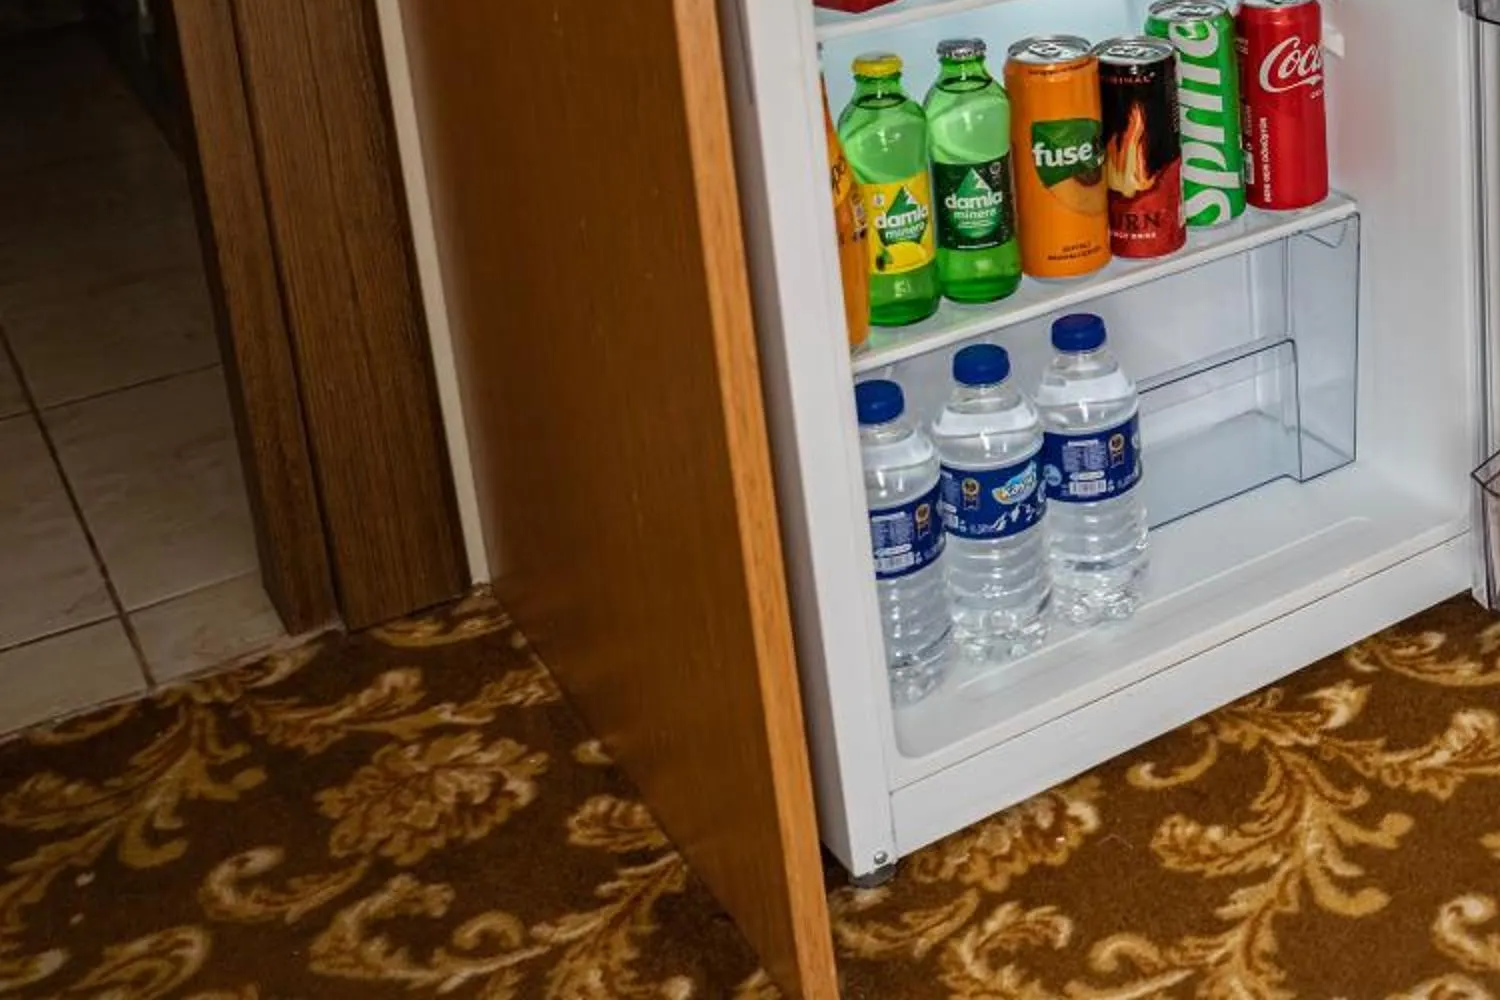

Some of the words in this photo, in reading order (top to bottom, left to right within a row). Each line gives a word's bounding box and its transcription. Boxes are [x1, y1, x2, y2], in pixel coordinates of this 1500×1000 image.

[1031, 141, 1093, 167] fuse
[944, 190, 1003, 209] damla
[874, 202, 929, 229] damla
